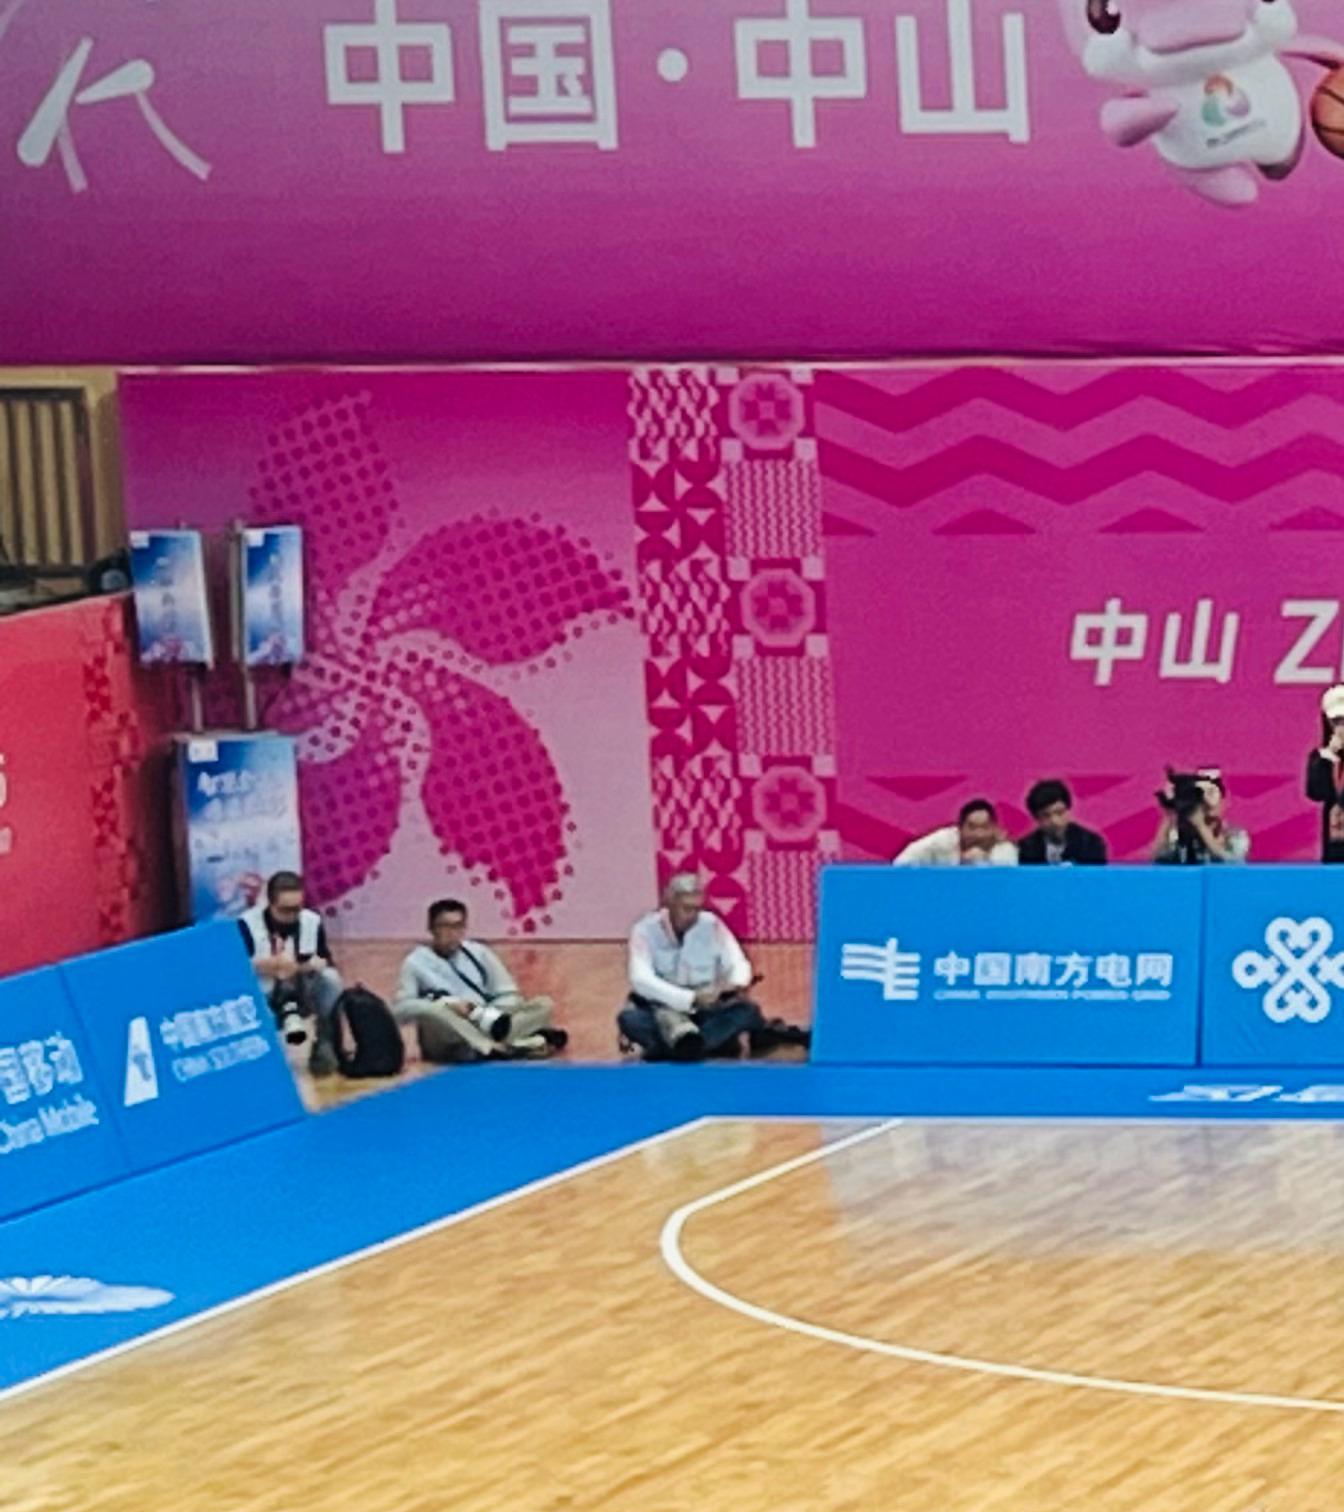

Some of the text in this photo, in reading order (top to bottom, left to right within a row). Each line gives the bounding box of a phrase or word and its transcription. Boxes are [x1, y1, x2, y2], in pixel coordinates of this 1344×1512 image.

[1070, 598, 1240, 686] 中山
[933, 949, 1174, 988] 中国南方电网
